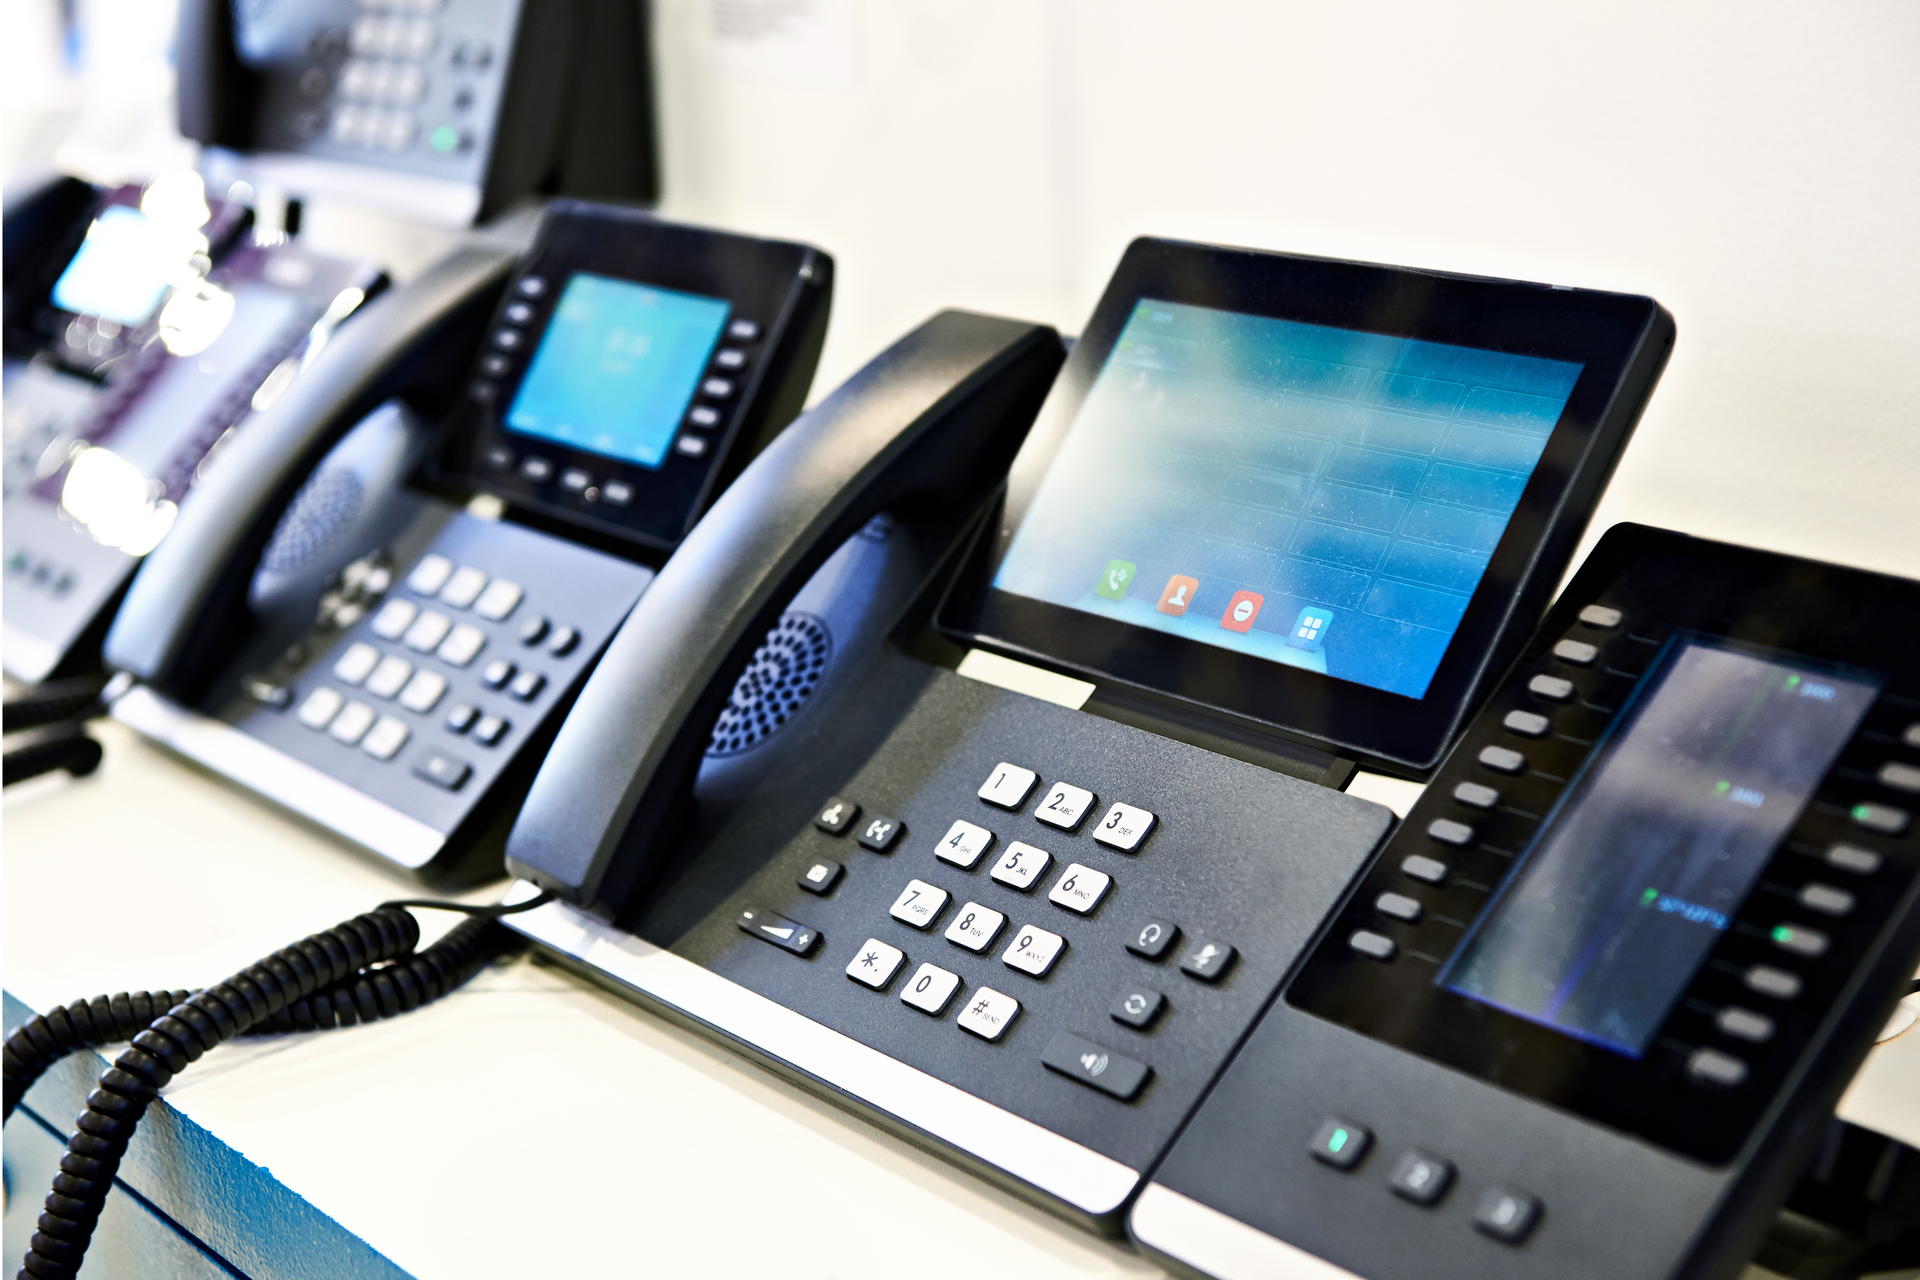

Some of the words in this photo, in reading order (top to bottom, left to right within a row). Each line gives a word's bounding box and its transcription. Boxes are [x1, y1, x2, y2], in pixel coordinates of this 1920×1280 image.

[994, 773, 1006, 789] 1
[1047, 792, 1065, 811] 2
[1058, 806, 1074, 816] ABC
[1106, 811, 1123, 829] 3
[1118, 826, 1133, 836] DEF
[948, 832, 965, 848] 4
[959, 845, 971, 855] GHI
[1005, 852, 1023, 869] 5
[1015, 867, 1028, 876] JKL
[903, 890, 921, 907] 7
[1062, 874, 1079, 892] 6
[1073, 889, 1090, 900] MNO
[911, 904, 929, 916] PQRS
[959, 913, 976, 931] 8
[969, 927, 984, 938] TUV
[1016, 935, 1033, 953] 9
[1025, 951, 1045, 963] WXYZ
[915, 975, 932, 993] 0
[972, 999, 990, 1016] #
